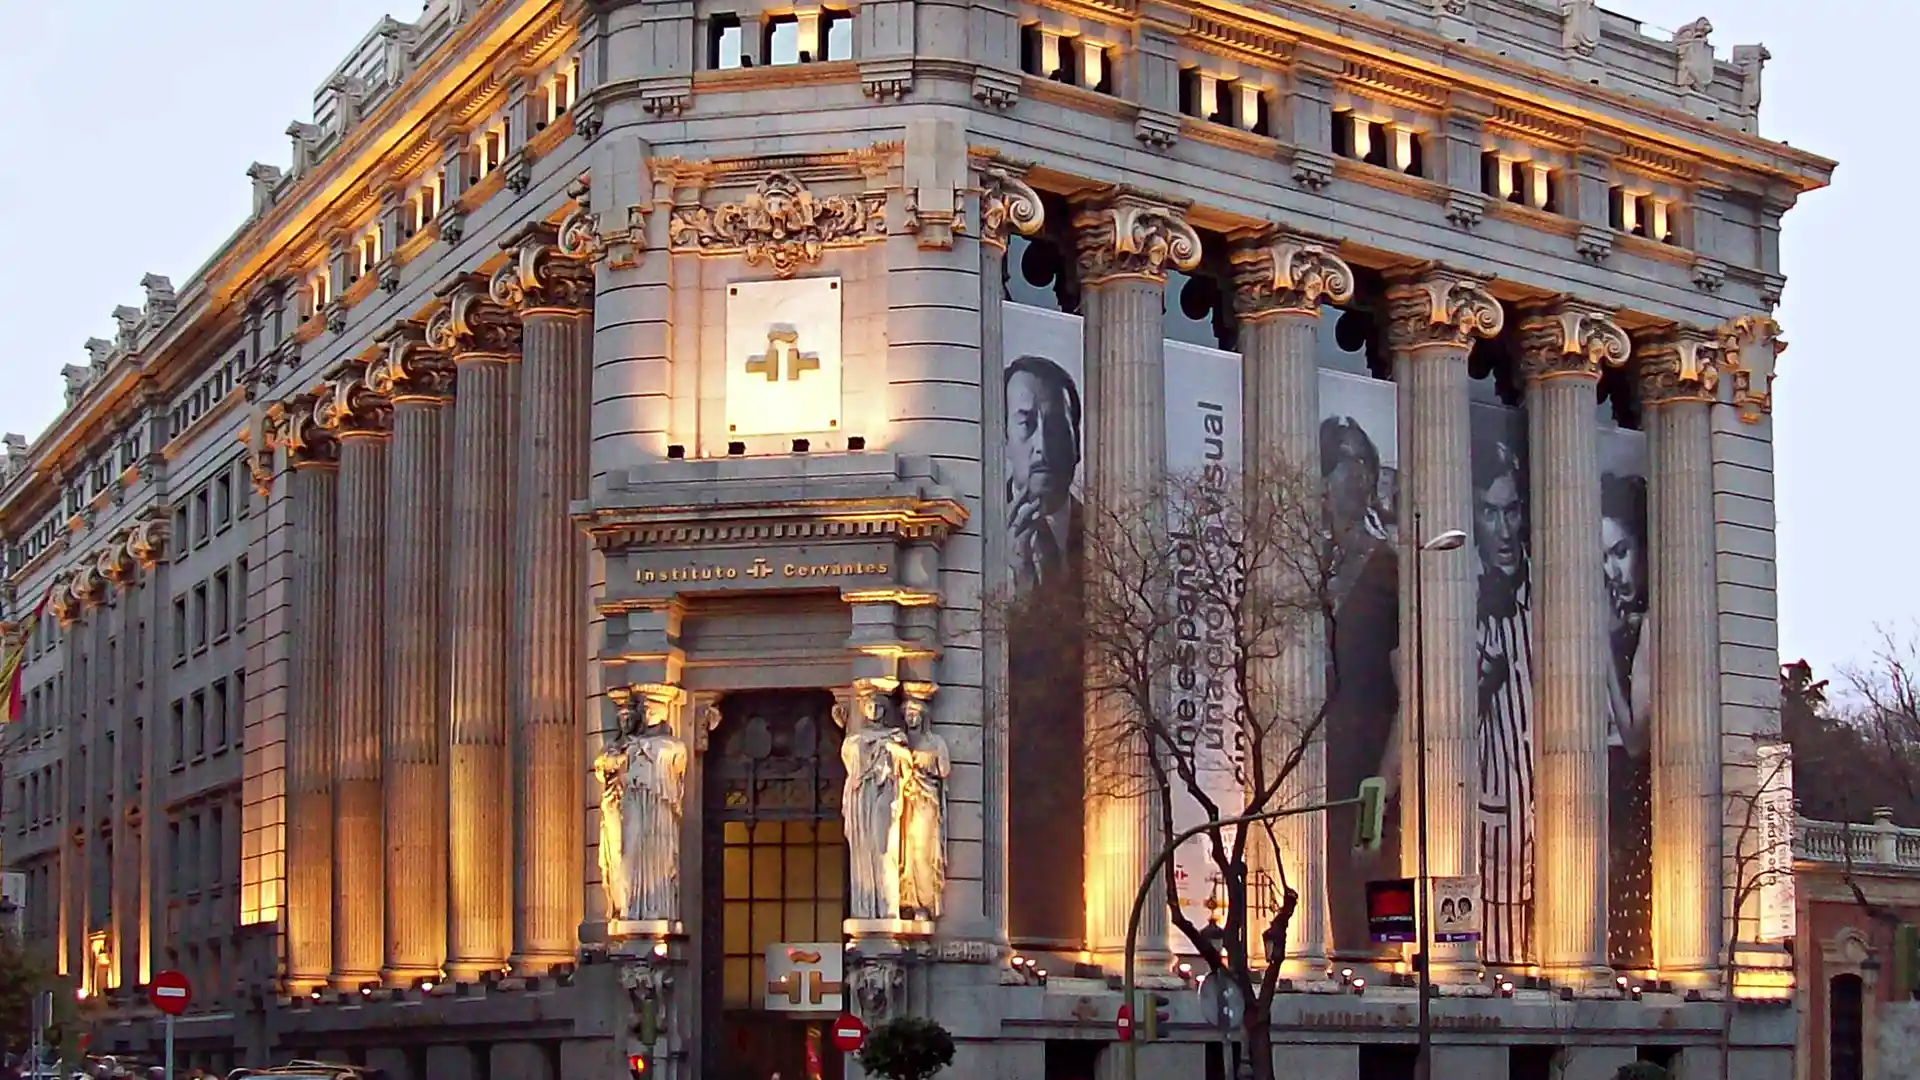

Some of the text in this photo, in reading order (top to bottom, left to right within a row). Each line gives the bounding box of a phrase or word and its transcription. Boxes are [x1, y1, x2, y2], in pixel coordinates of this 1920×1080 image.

[1197, 401, 1225, 517] visual
[635, 562, 889, 583] Instituto Cervantes
[1205, 680, 1224, 750] una
